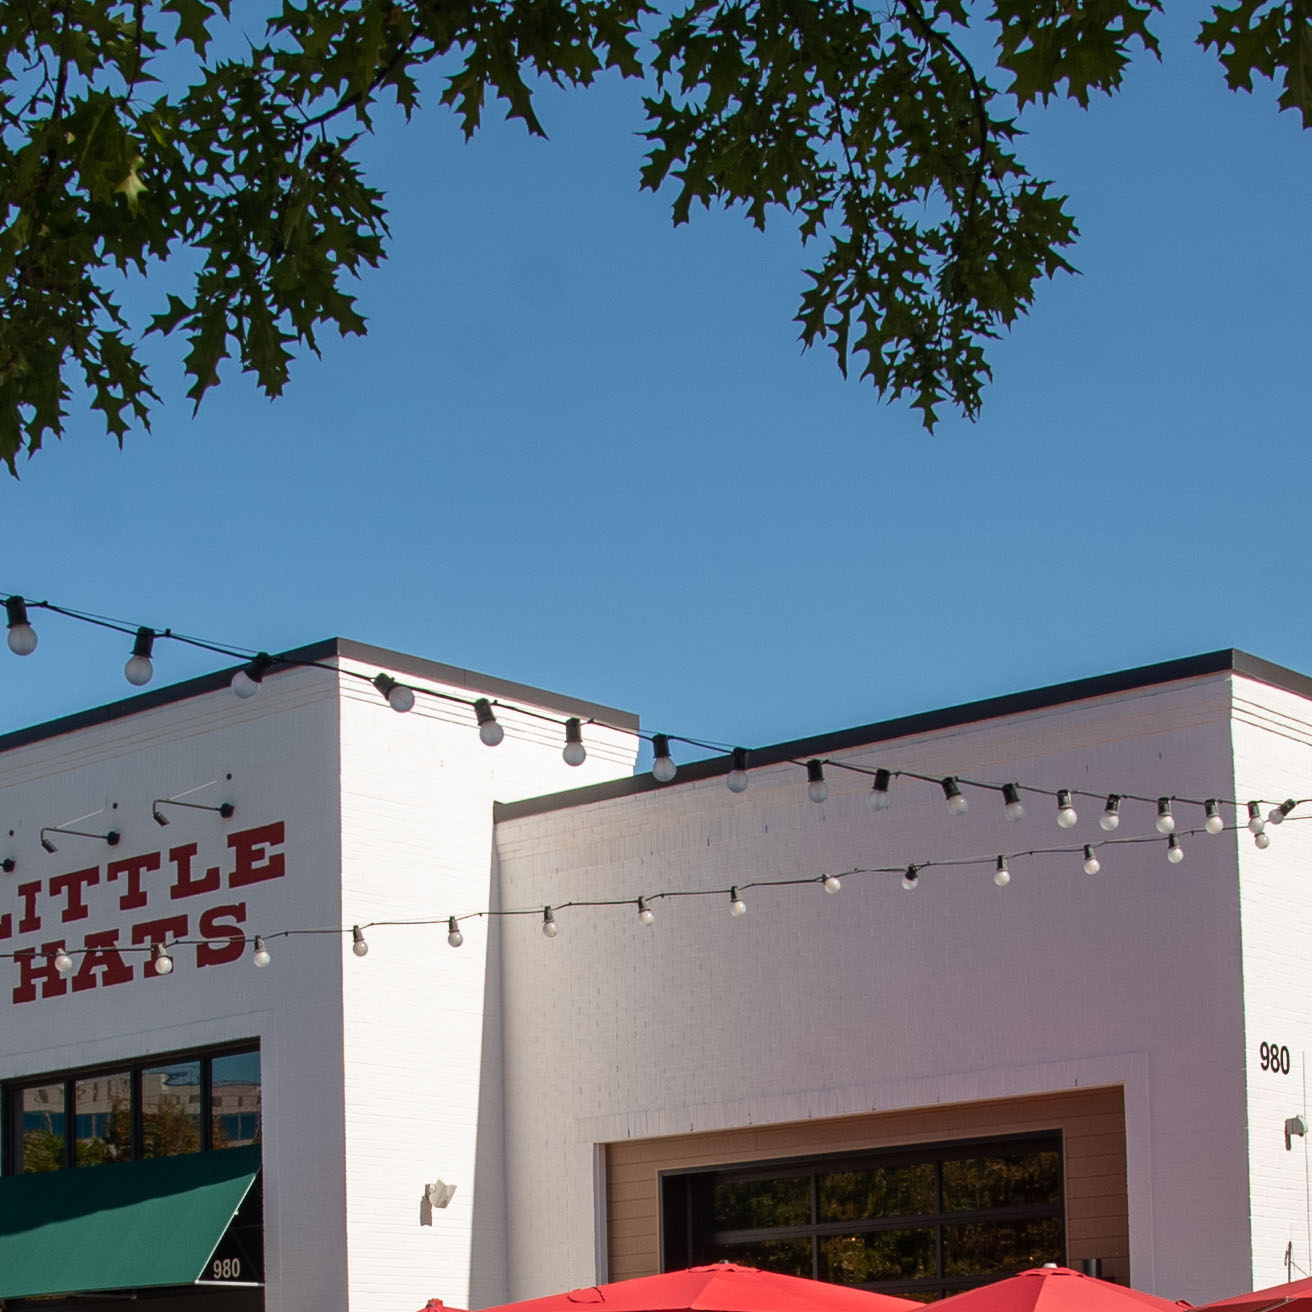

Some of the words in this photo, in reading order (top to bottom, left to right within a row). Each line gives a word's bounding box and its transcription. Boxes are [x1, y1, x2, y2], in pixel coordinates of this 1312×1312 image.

[12, 901, 247, 1005] HATS
[1259, 1041, 1290, 1075] 980
[213, 1257, 241, 1280] 980
